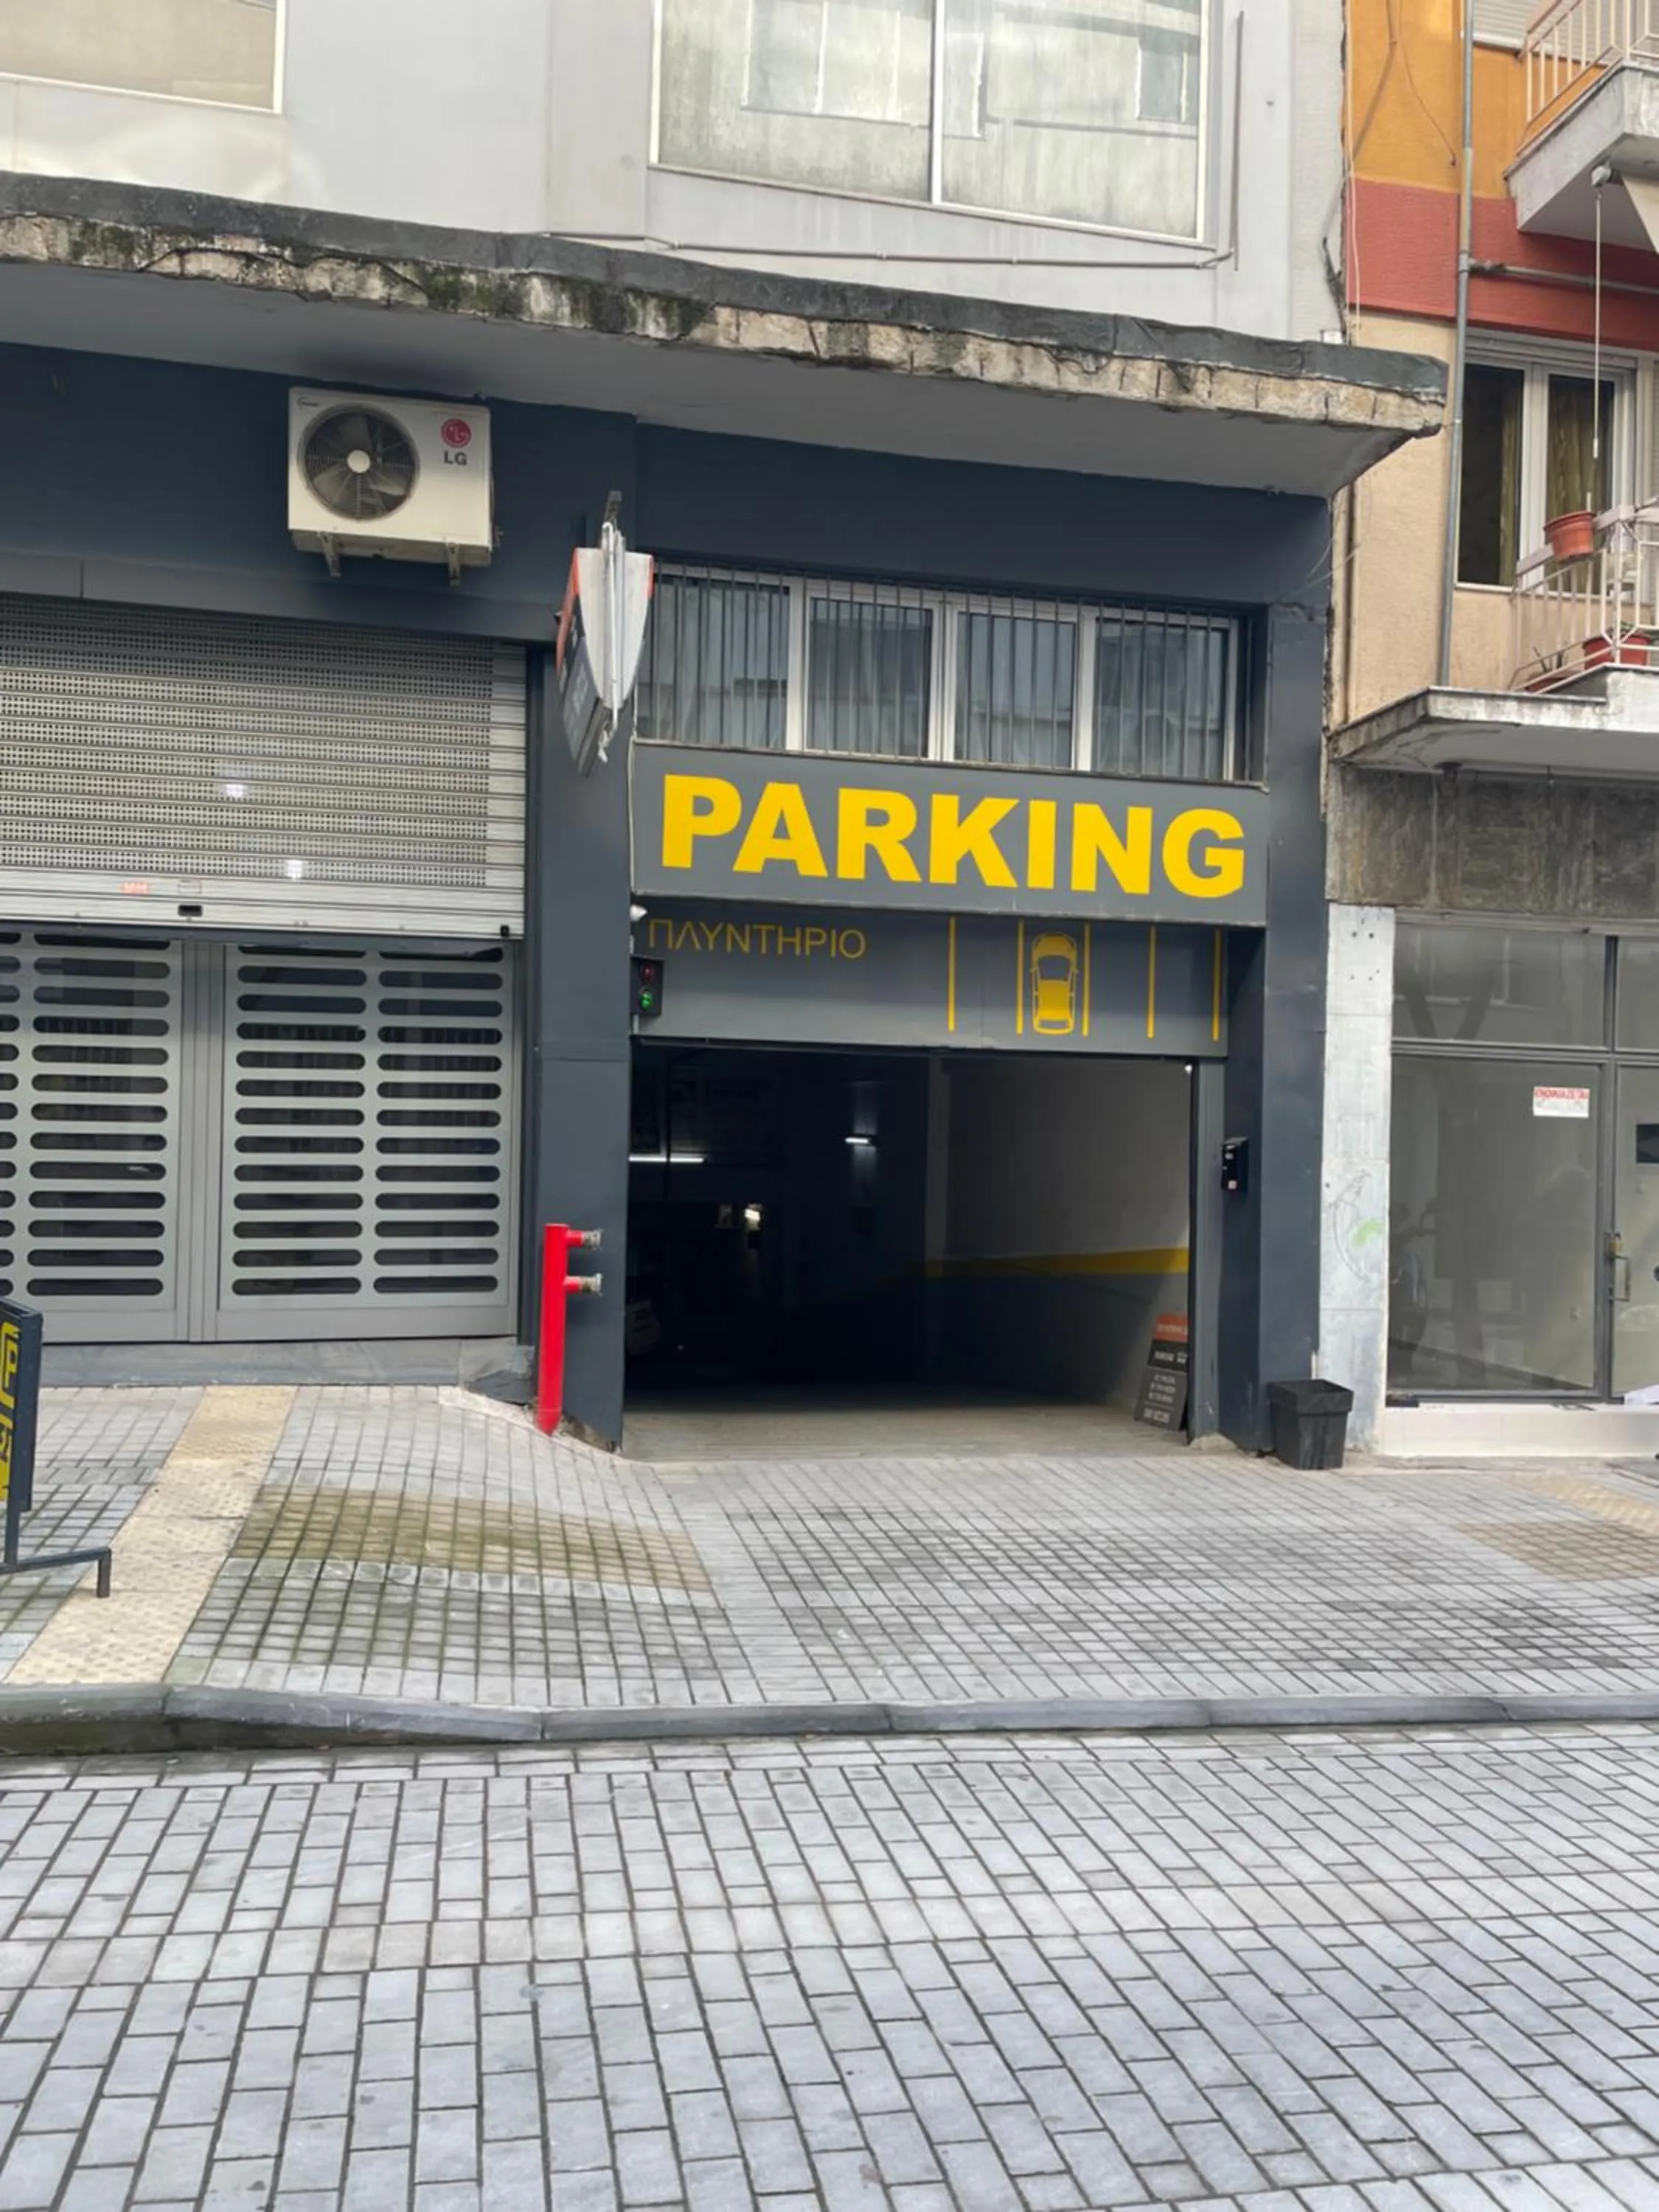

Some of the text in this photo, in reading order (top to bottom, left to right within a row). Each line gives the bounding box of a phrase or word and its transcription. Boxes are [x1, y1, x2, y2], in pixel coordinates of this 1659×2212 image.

[443, 450, 468, 466] LG
[661, 773, 1245, 899] PARKING
[648, 918, 866, 959] ΠΛΥΝΤΗΡΙΟ
